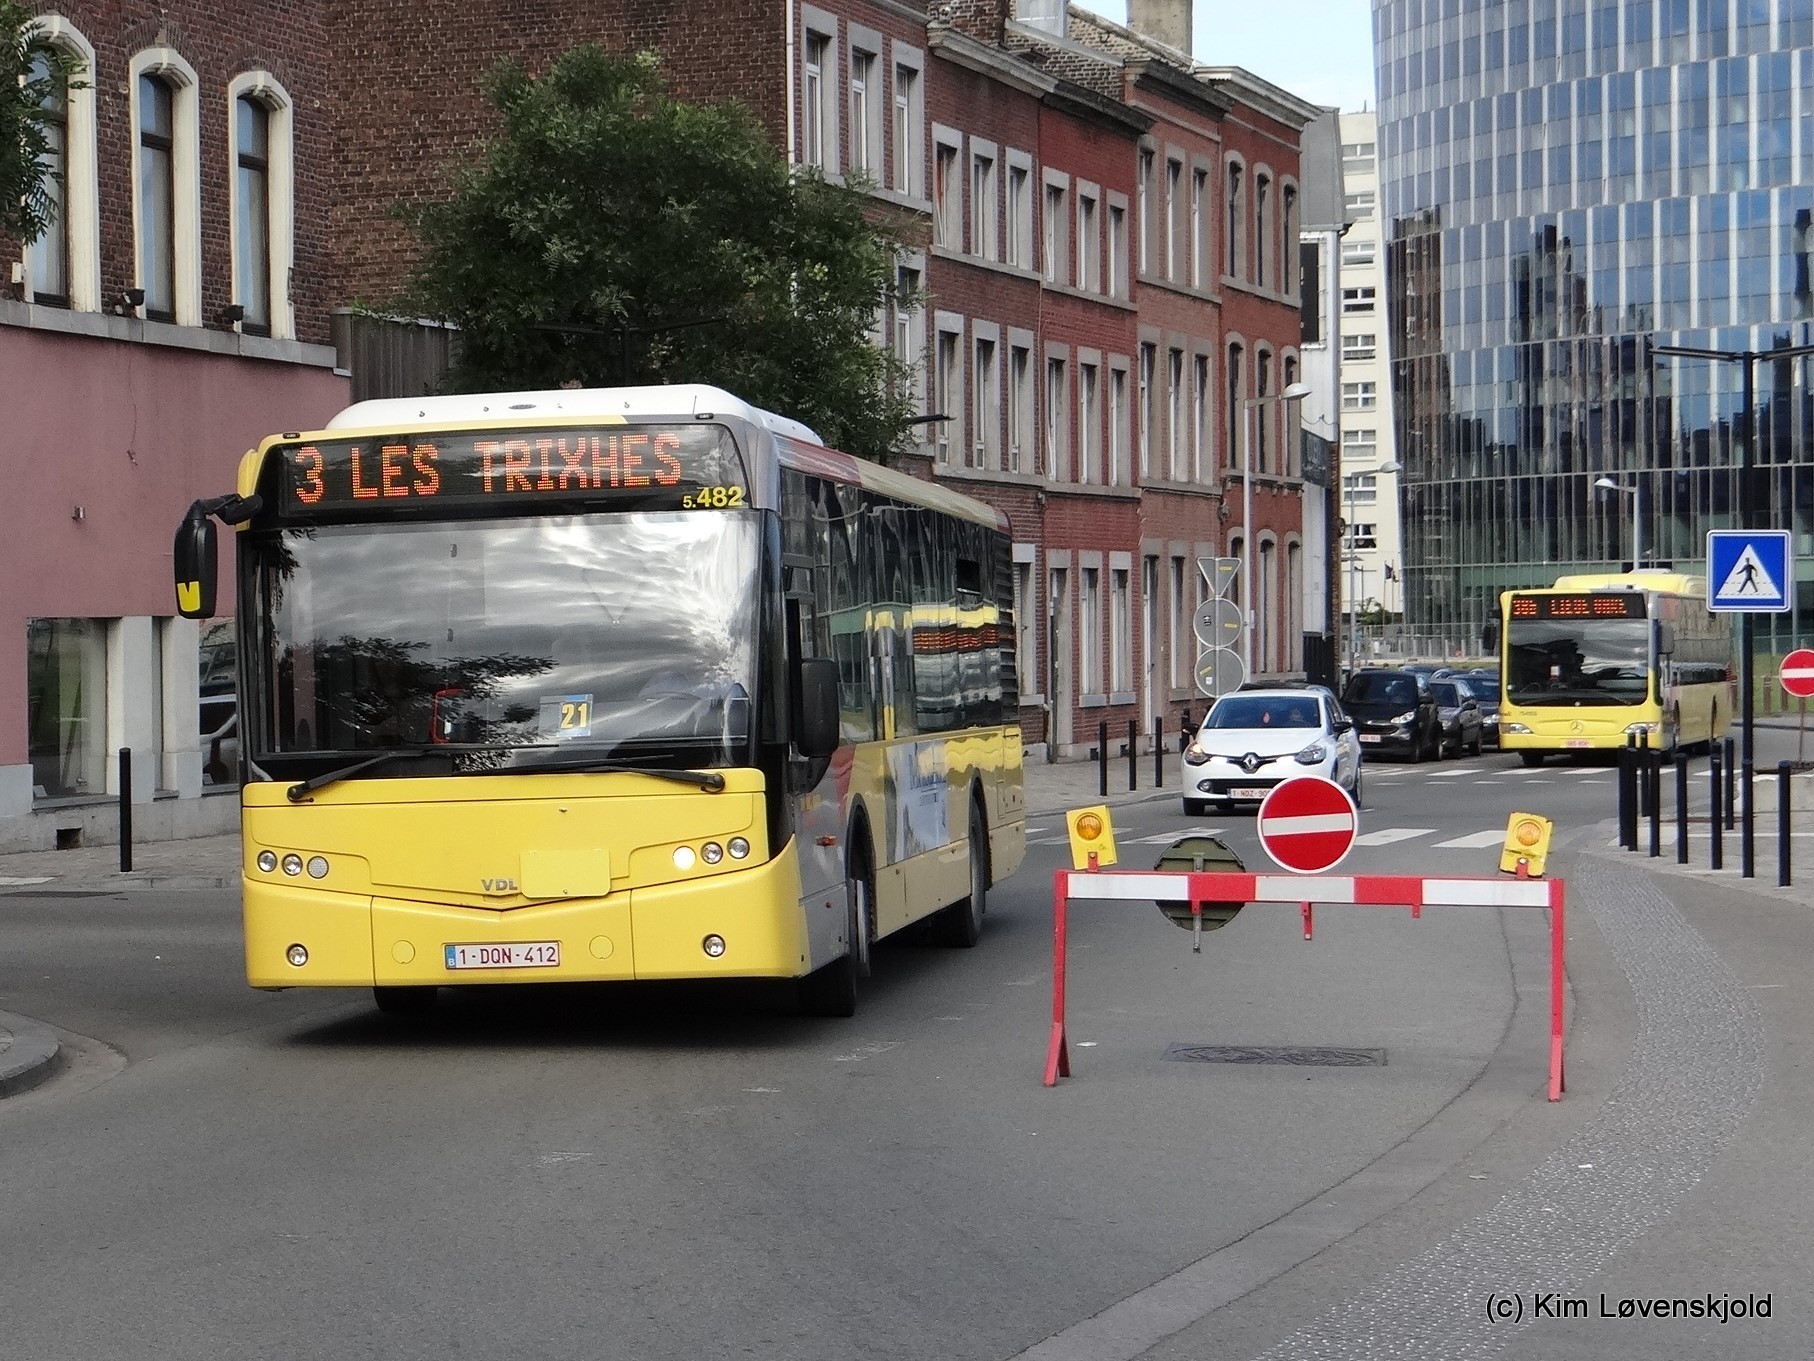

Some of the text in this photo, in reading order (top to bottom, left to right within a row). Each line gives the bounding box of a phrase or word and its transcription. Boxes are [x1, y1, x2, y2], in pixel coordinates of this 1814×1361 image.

[295, 432, 682, 504] 3 LES TRIXHES
[682, 485, 743, 509] 5.482
[560, 702, 588, 729] 21
[481, 879, 518, 891] VDL
[448, 946, 557, 967] B 1-DQN-412
